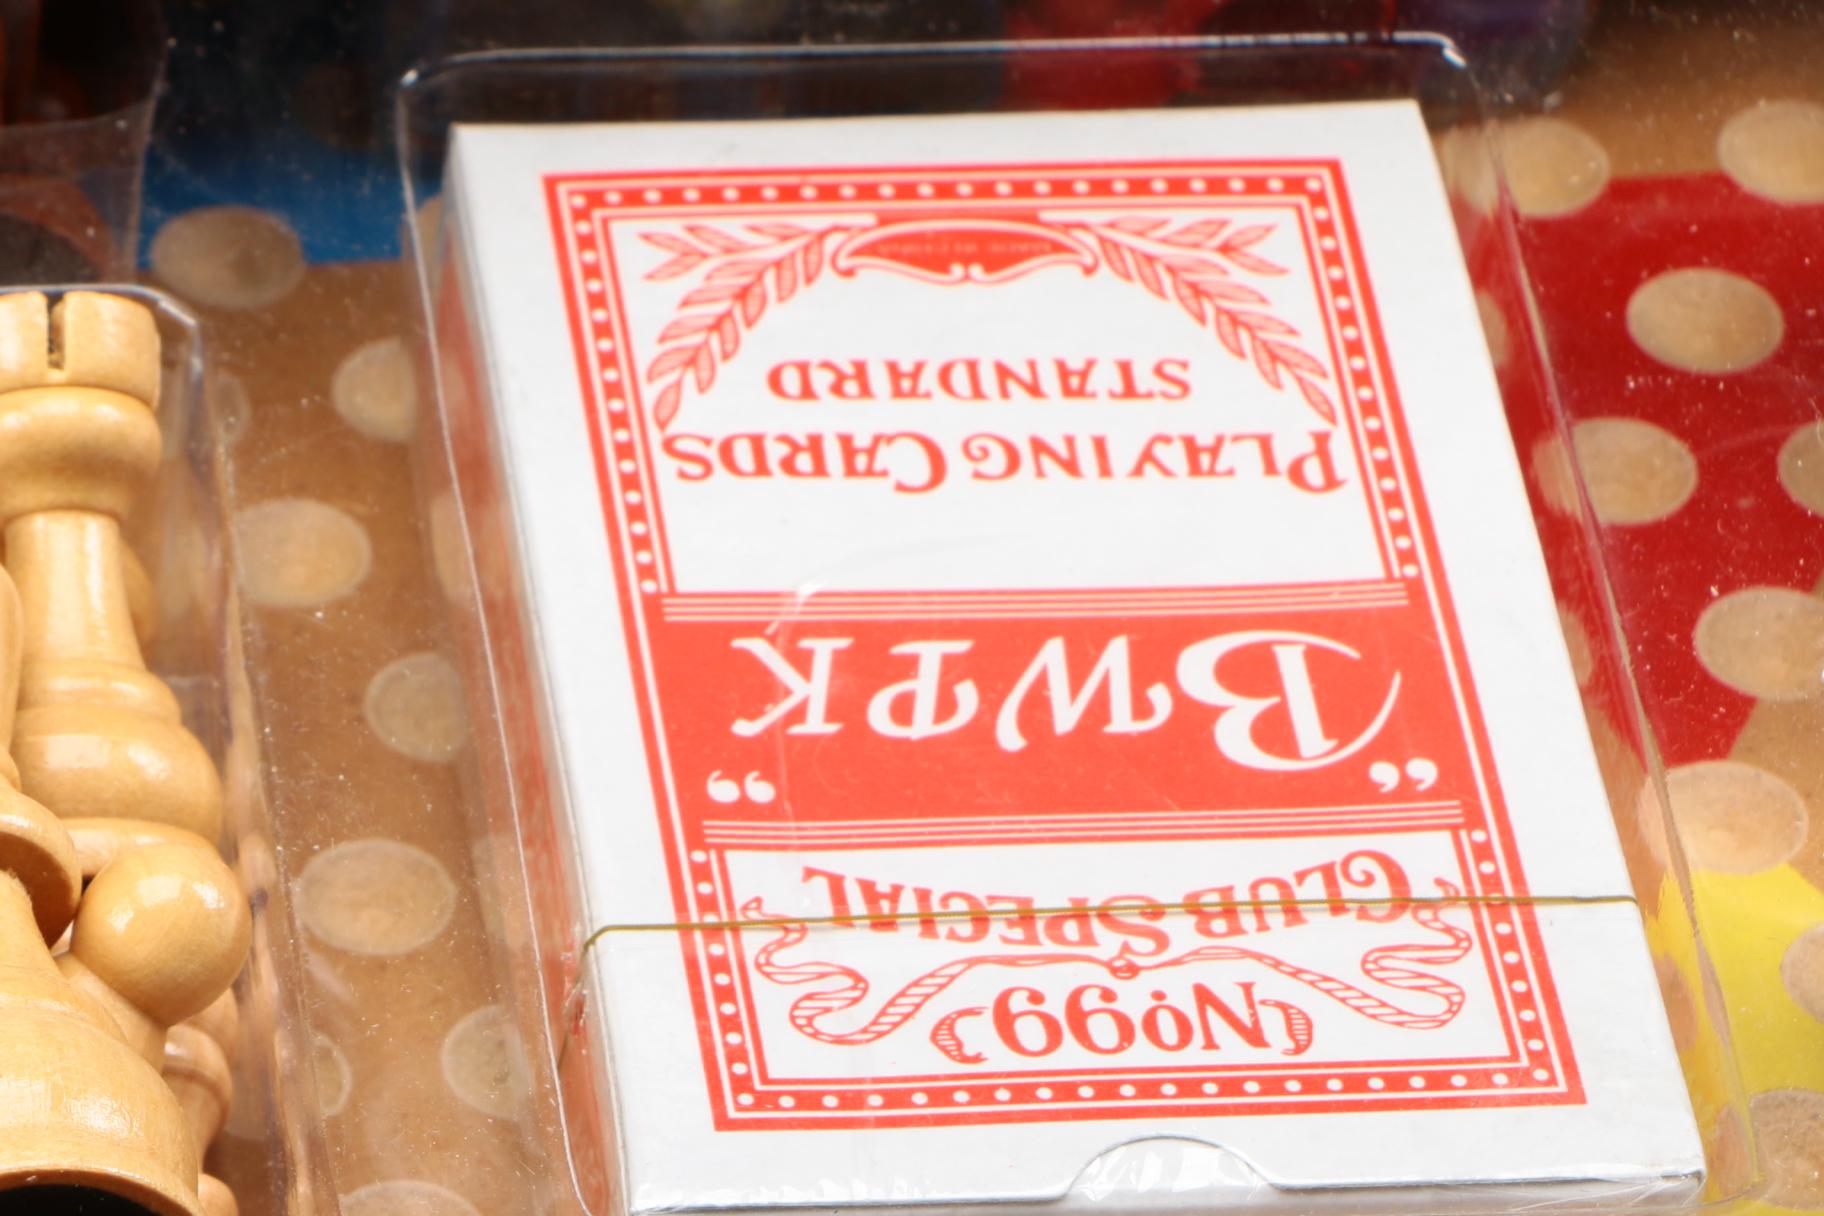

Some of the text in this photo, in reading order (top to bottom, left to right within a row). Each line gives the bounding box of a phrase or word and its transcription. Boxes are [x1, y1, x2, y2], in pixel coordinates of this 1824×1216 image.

[767, 358, 1191, 400] STANDARD
[661, 429, 1349, 494] PLAYING CARDS
[801, 849, 1413, 957] CLUB SPECIAL
